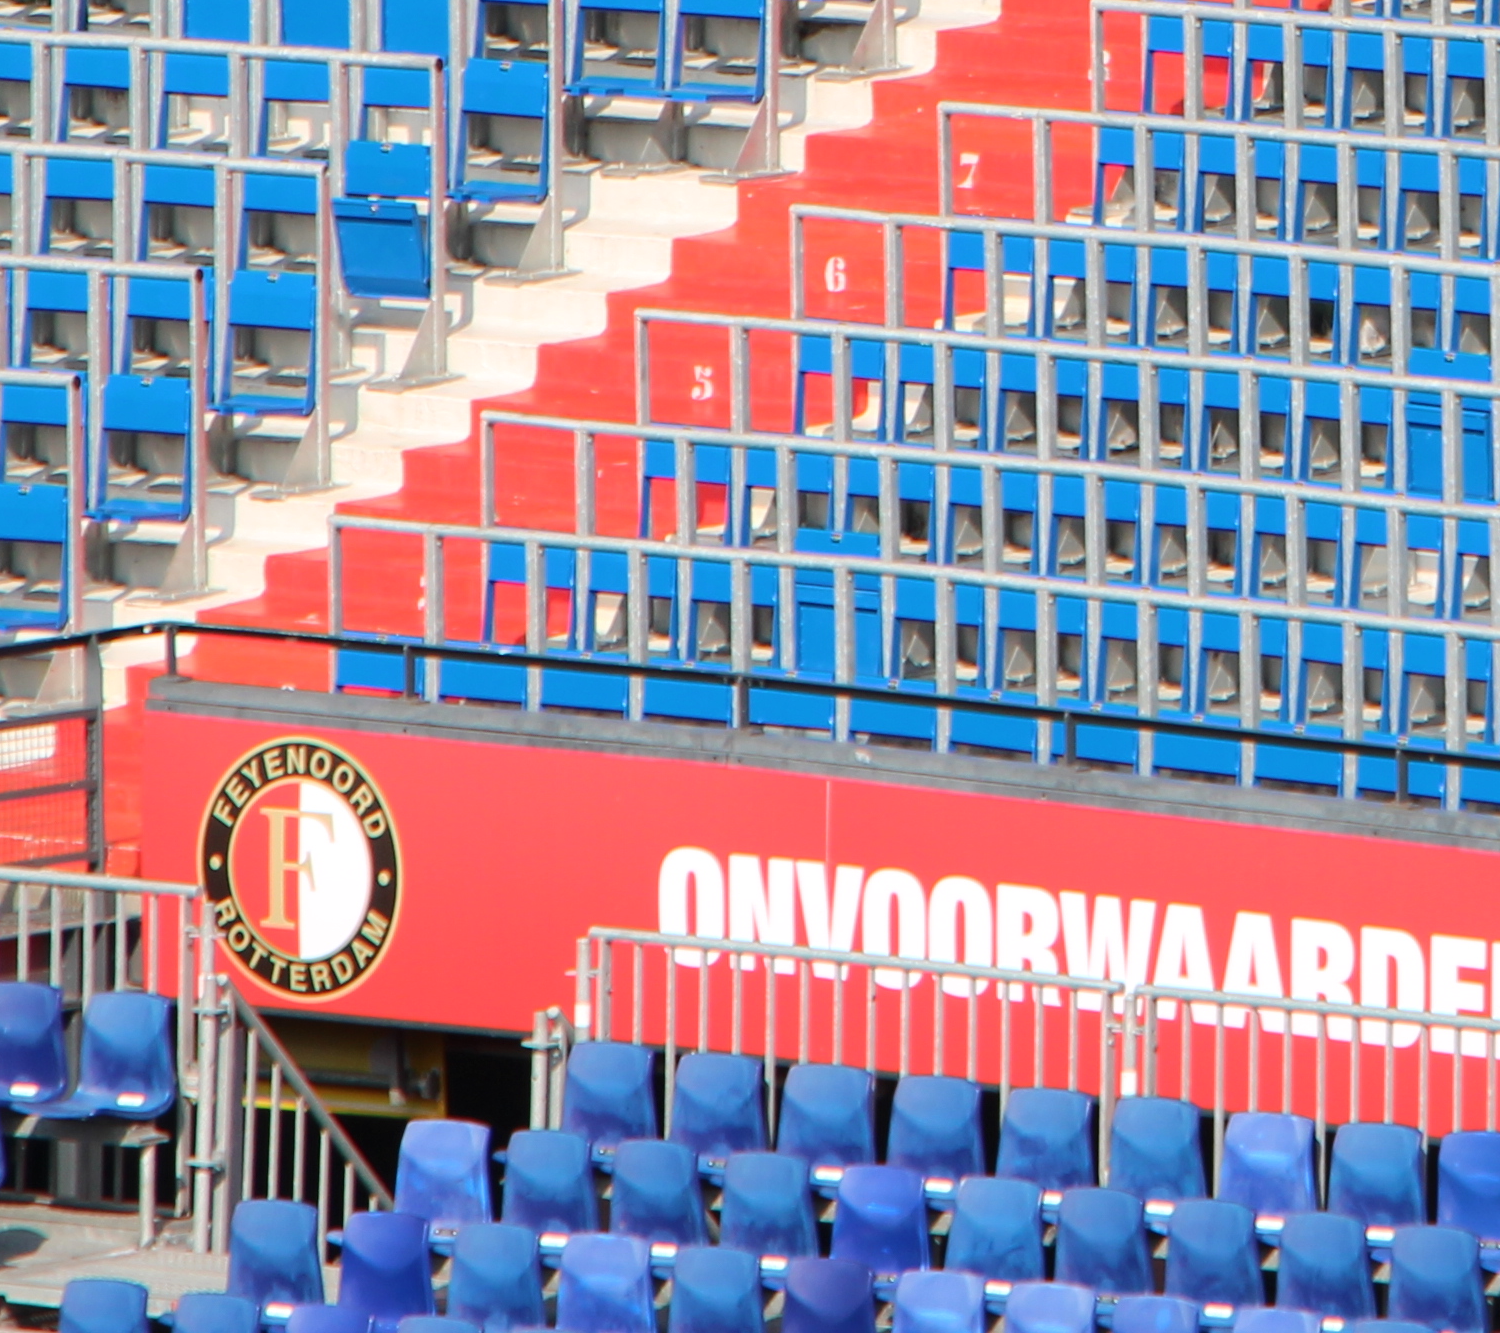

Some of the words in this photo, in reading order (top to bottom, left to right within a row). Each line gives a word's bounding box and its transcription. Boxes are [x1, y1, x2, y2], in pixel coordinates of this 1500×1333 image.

[957, 152, 981, 190] 7
[823, 256, 847, 294] 6
[691, 364, 714, 402] 5
[212, 746, 387, 840] FEYENOORD
[259, 806, 336, 931] F
[214, 898, 390, 993] ROTTERDAM
